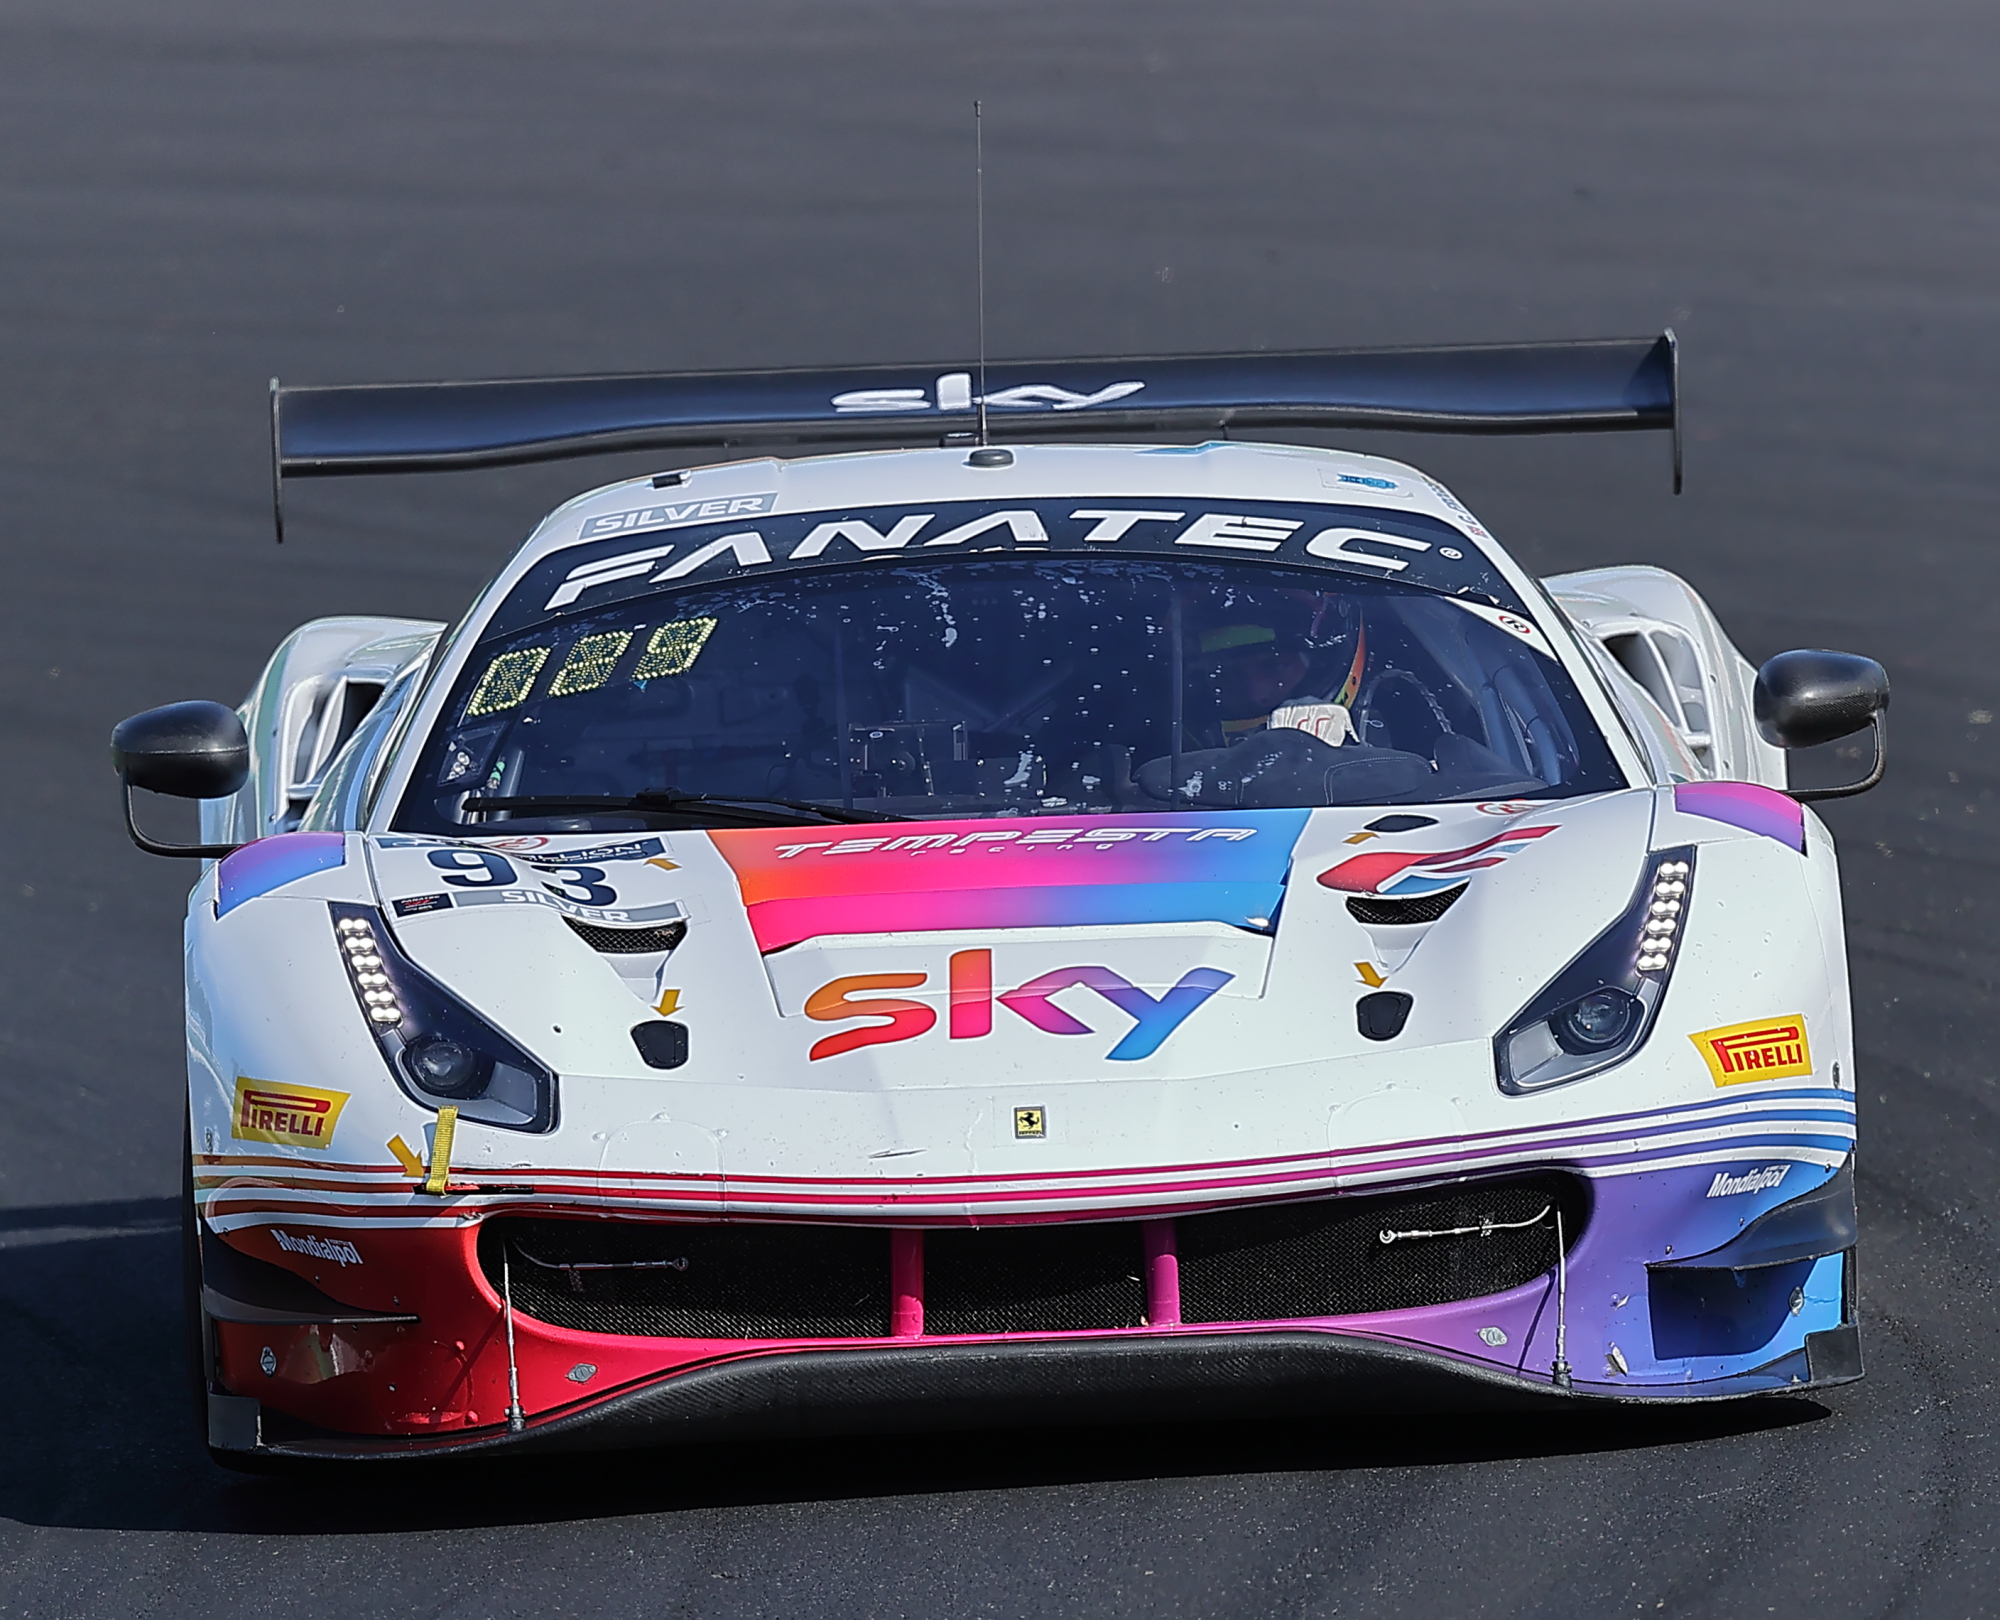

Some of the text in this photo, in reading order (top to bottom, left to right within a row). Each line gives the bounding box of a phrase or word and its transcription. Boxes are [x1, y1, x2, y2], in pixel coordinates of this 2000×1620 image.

[830, 372, 1146, 412] sky
[592, 496, 763, 534] SILVER
[544, 509, 1432, 610] FANATEC
[775, 827, 1259, 859] TEMPESTA
[427, 849, 618, 906] 93
[501, 891, 632, 922] SILVER
[804, 948, 1237, 1062] sky
[1709, 1026, 1804, 1073] PIRELLI
[241, 1089, 332, 1137] PIRELLI
[1706, 1164, 1792, 1198] Mondialpol
[270, 1229, 364, 1267] Mondialpol
